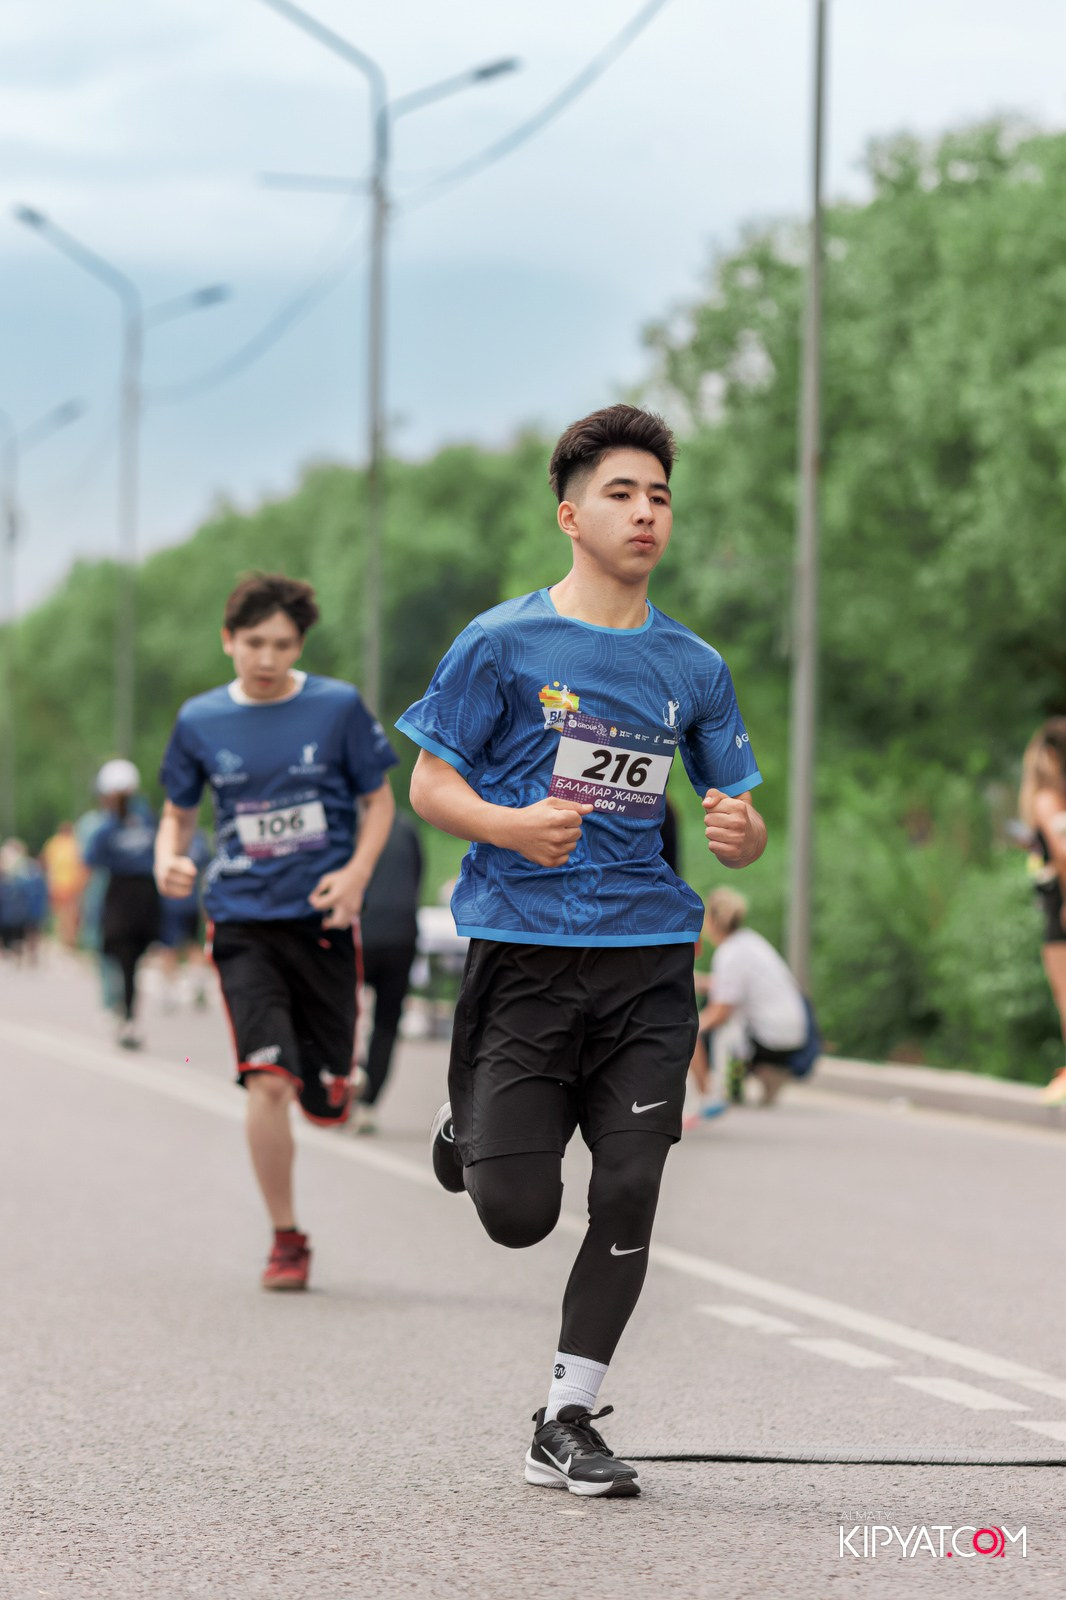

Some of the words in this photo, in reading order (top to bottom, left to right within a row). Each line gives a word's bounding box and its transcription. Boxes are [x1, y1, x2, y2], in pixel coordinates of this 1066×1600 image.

[581, 749, 653, 787] 216
[555, 778, 612, 797] БАЛАЛАР
[612, 790, 658, 805] ЖАРЫСЫ
[594, 798, 616, 811] 600
[257, 814, 304, 836] 106
